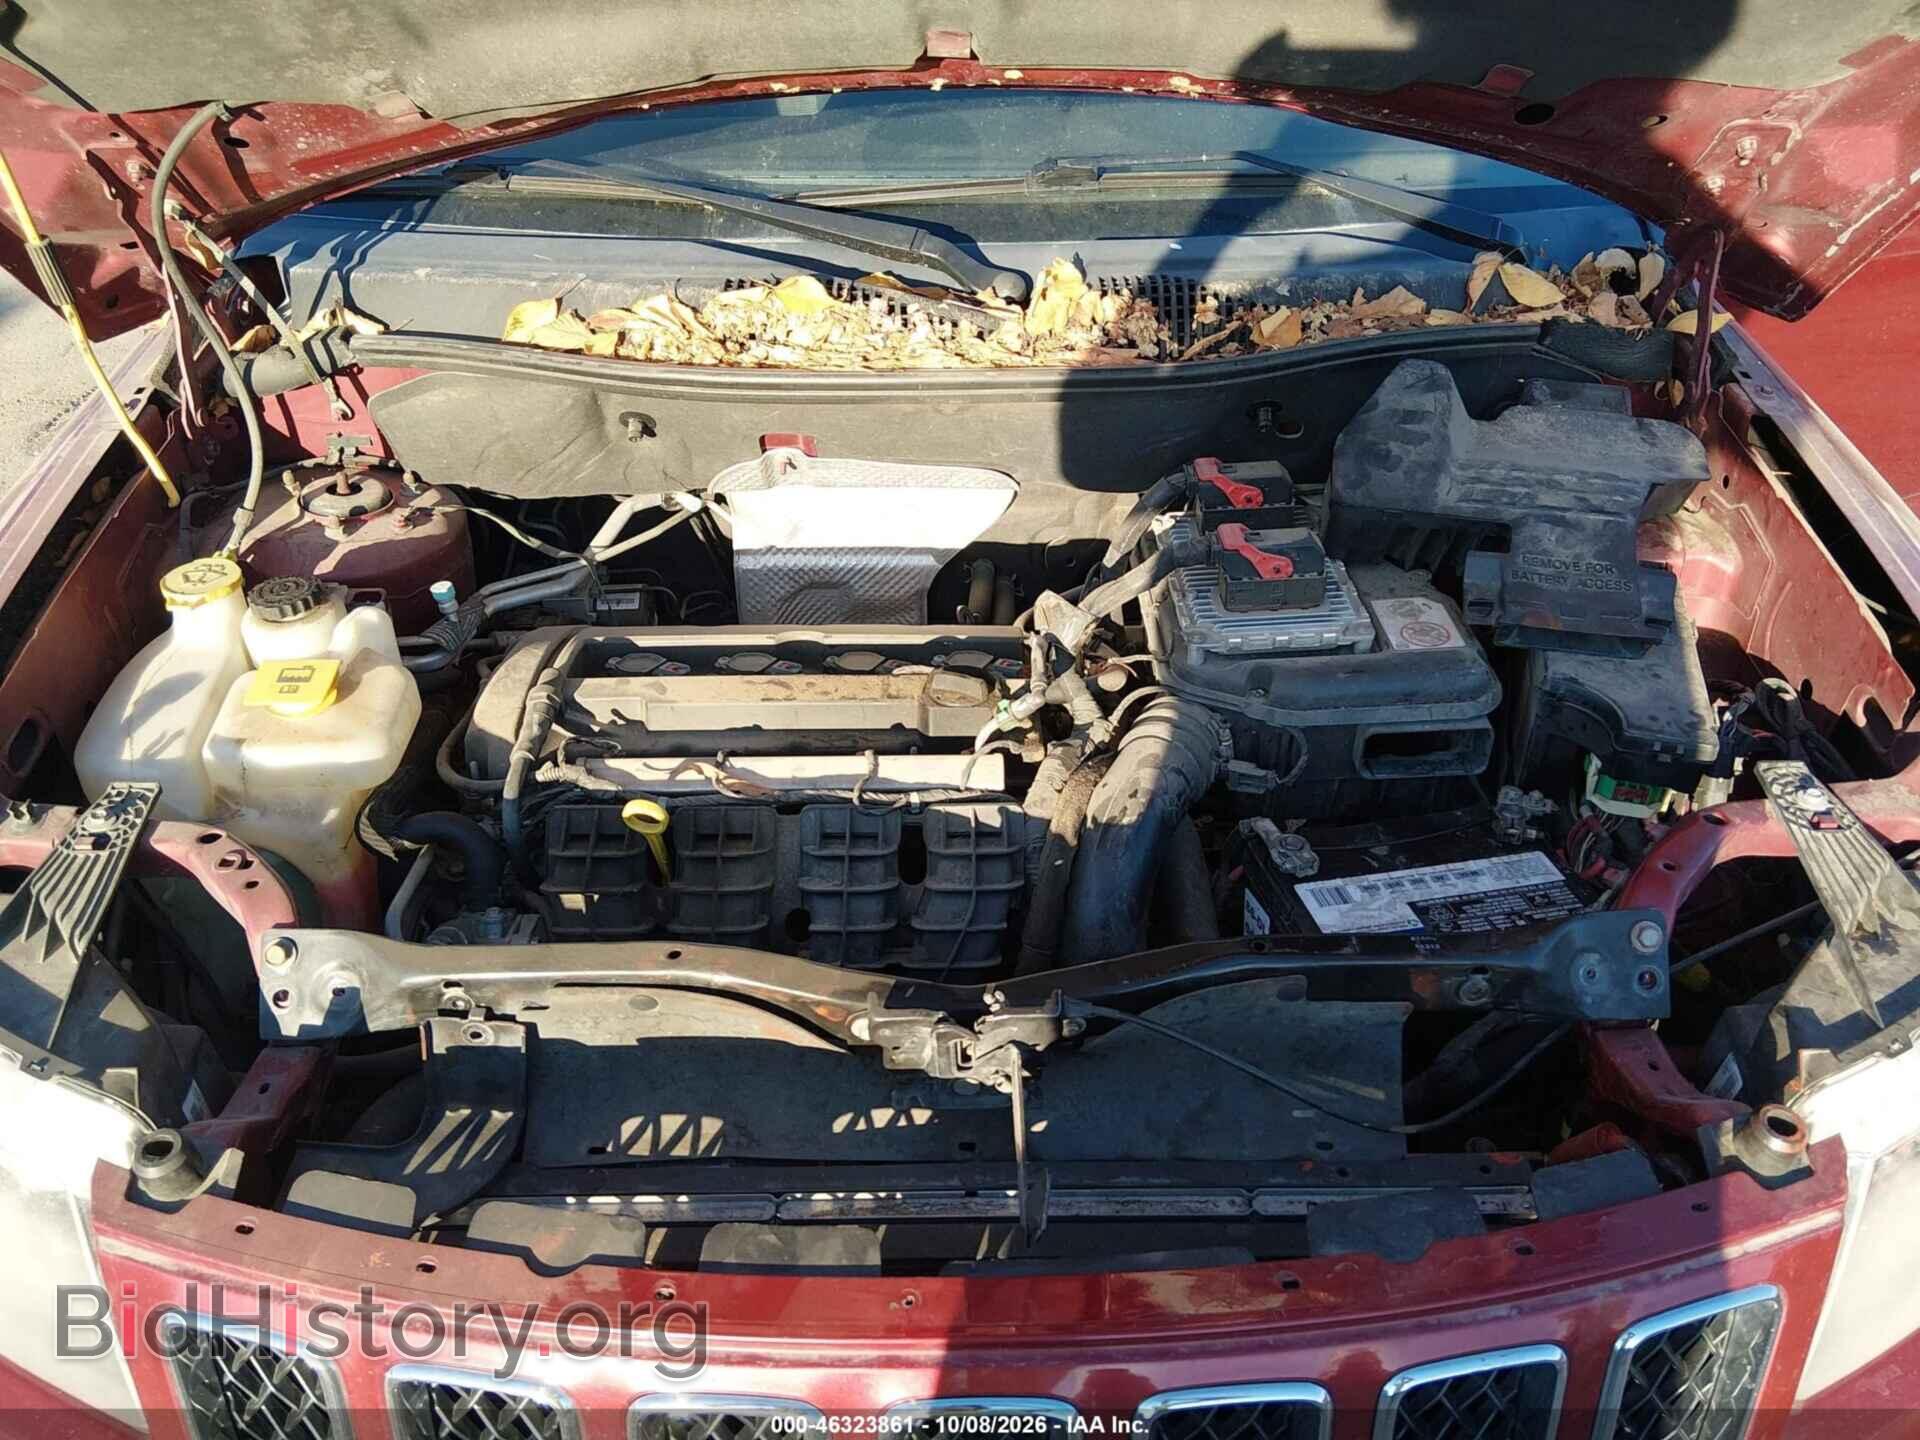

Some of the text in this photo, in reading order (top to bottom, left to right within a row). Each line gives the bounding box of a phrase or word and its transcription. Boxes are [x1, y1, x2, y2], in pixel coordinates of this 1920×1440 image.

[1521, 555, 1616, 575] REMOVE FOR
[1511, 569, 1569, 585] BATTERY
